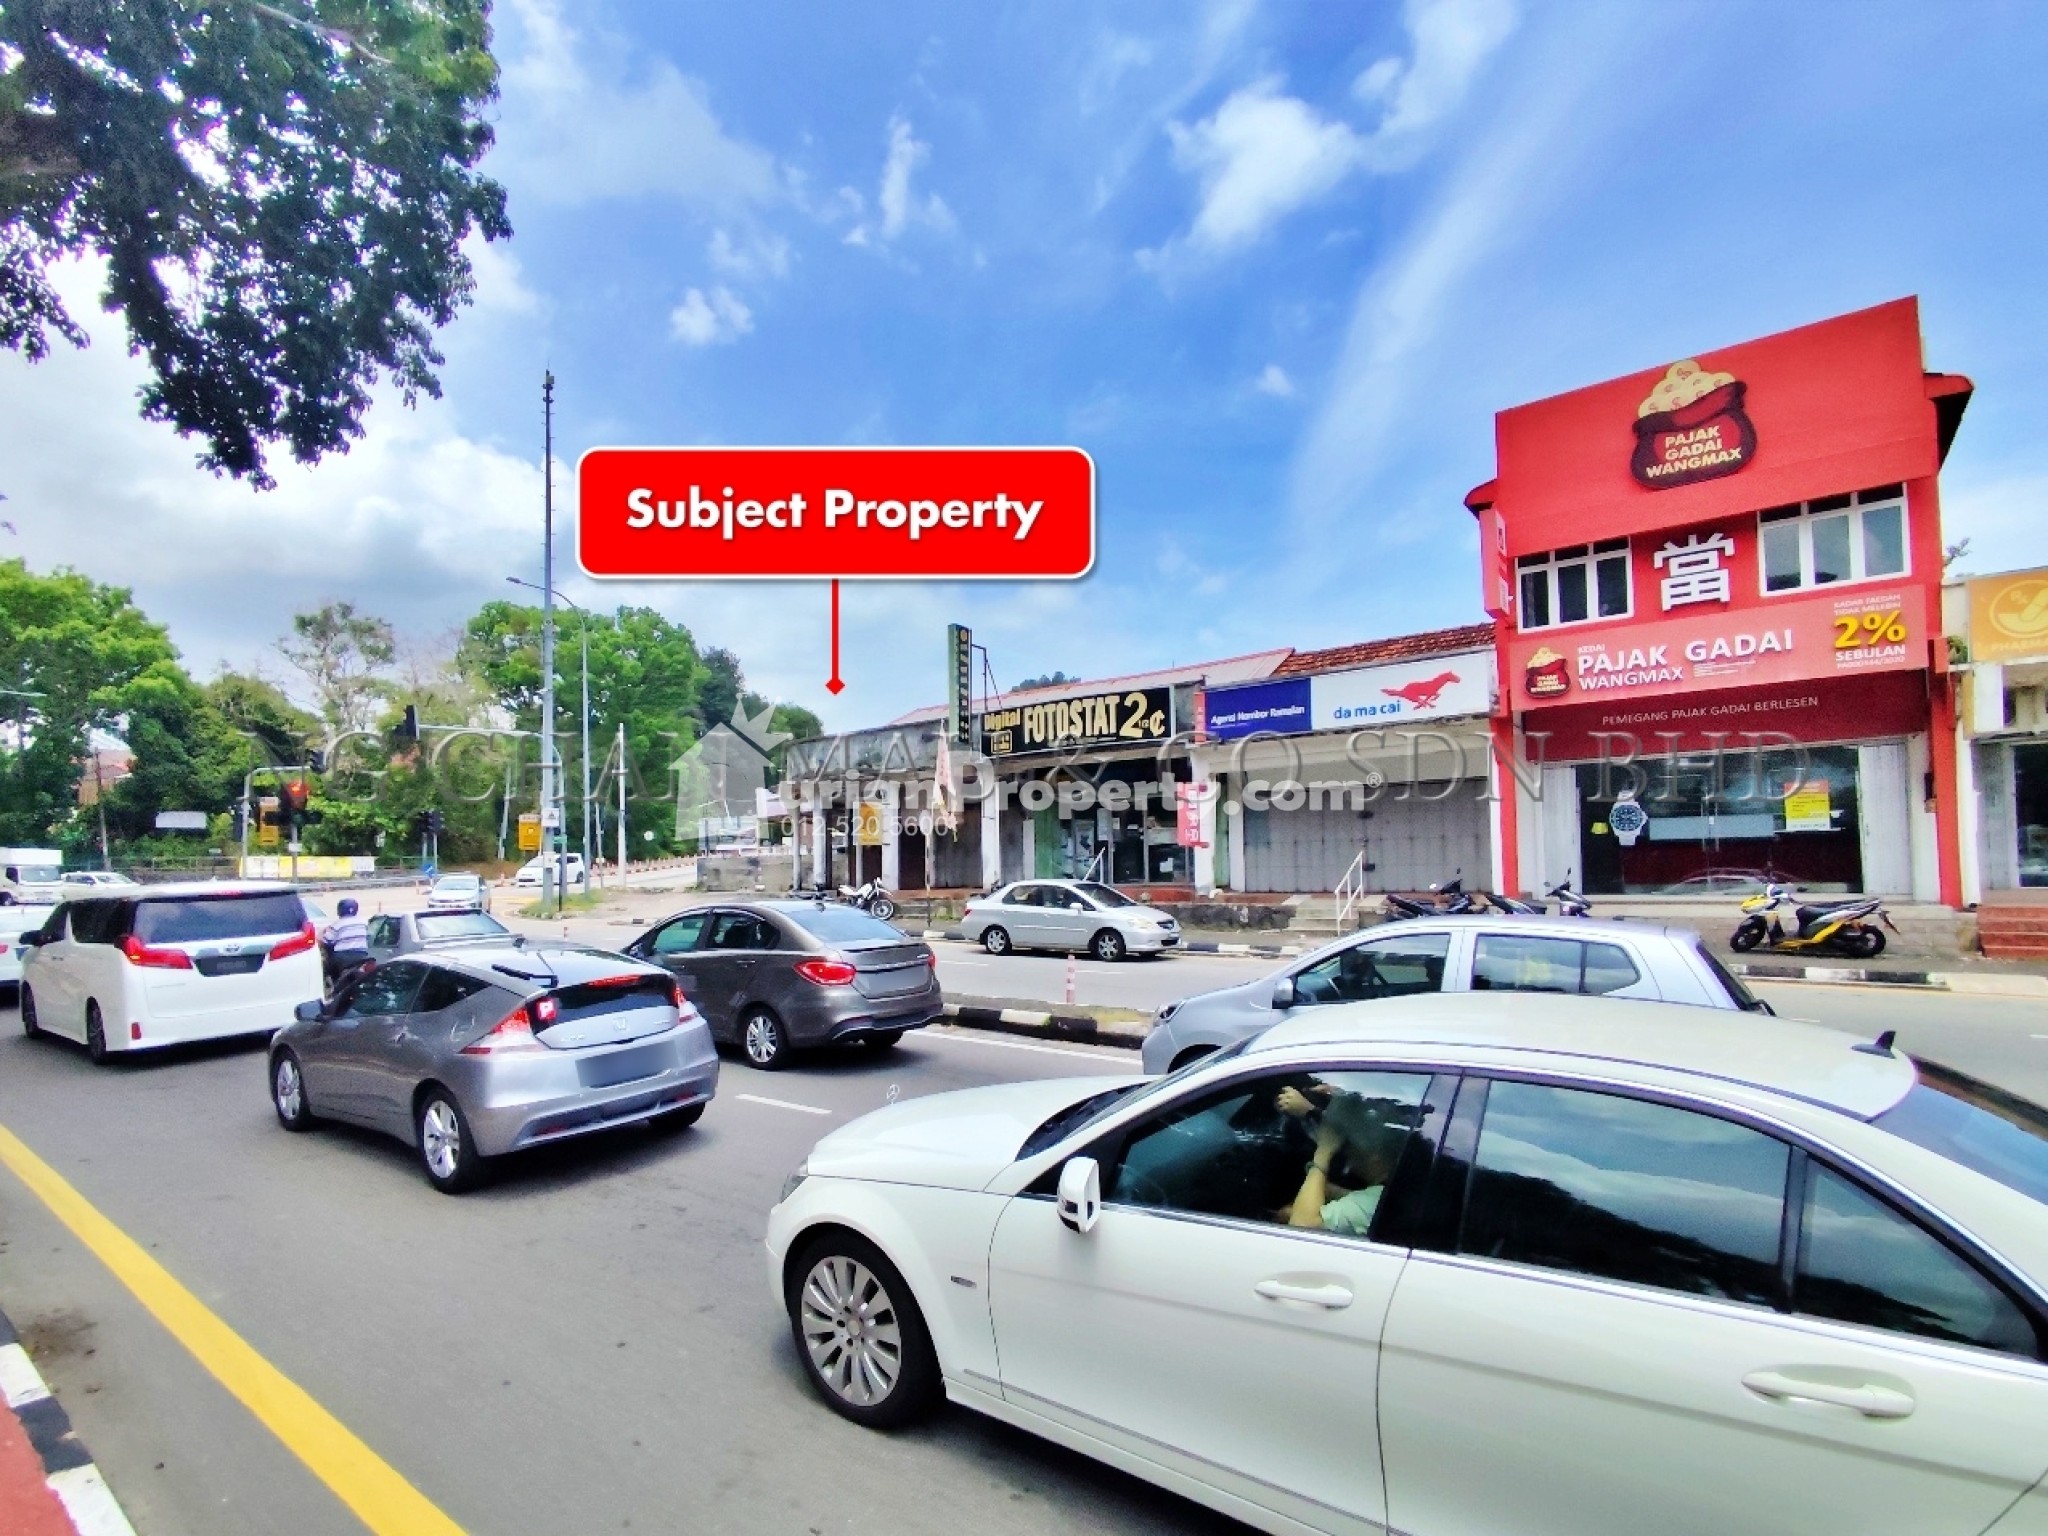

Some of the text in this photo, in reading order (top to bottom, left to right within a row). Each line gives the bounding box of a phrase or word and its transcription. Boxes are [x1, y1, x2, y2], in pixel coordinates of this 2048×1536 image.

[1665, 425, 1720, 448] PAJAK
[1665, 438, 1722, 460] GADAI
[1646, 447, 1742, 478] WANGMAX
[1653, 532, 1736, 612] 當
[1834, 610, 1906, 648] 2%
[1578, 645, 1669, 676] PAJAK
[1685, 629, 1793, 661] GADAI
[1835, 644, 1906, 661] SEBULAN
[1578, 666, 1684, 691] WANGMAX
[1024, 695, 1121, 745] FOTOSTAT
[1334, 699, 1401, 719] da ma cai
[1602, 696, 1819, 726] PEMEGANG PAJAK GADAI BERLESEN
